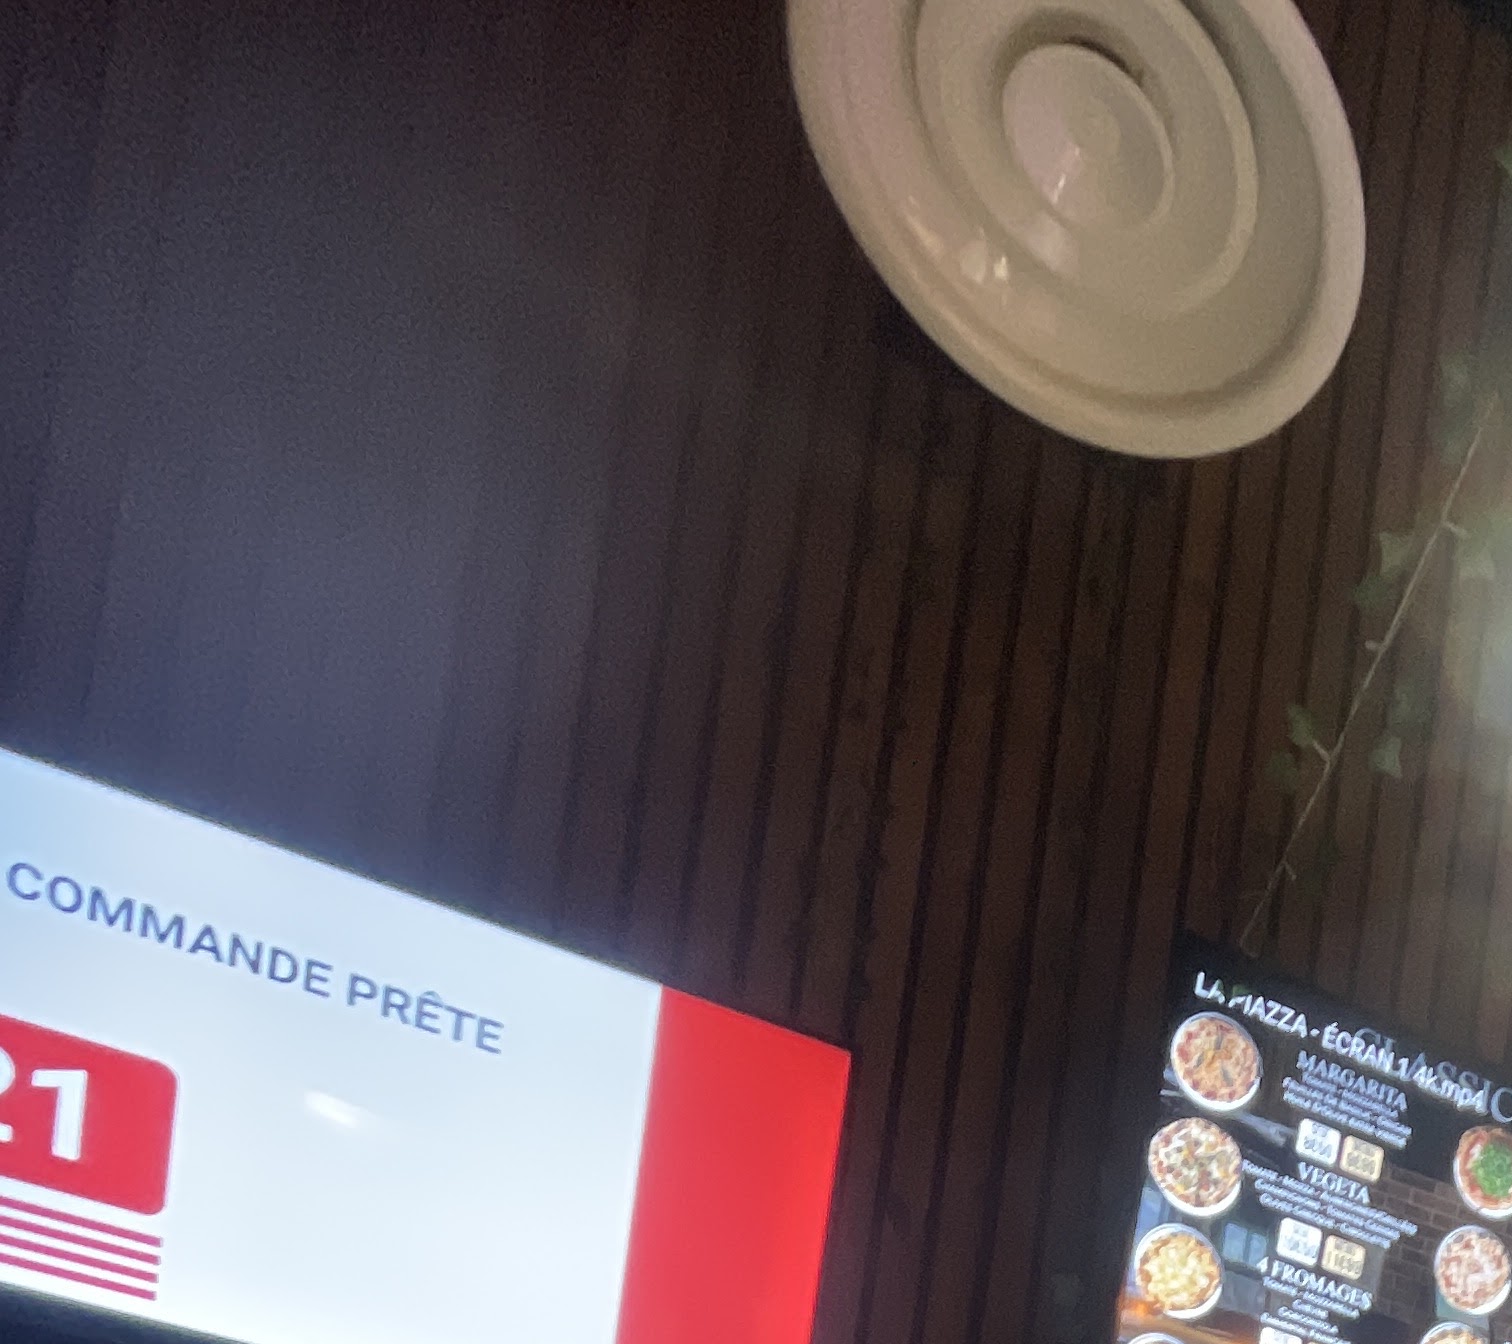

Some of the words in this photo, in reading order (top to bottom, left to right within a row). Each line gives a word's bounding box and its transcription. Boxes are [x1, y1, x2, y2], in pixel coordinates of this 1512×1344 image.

[5, 861, 332, 997] COMMANDE
[347, 970, 506, 1056] PRÊTE
[1296, 1048, 1409, 1113] MARGARITA
[1295, 1159, 1372, 1206] VEGETA
[1270, 1258, 1374, 1313] FROMAGES
